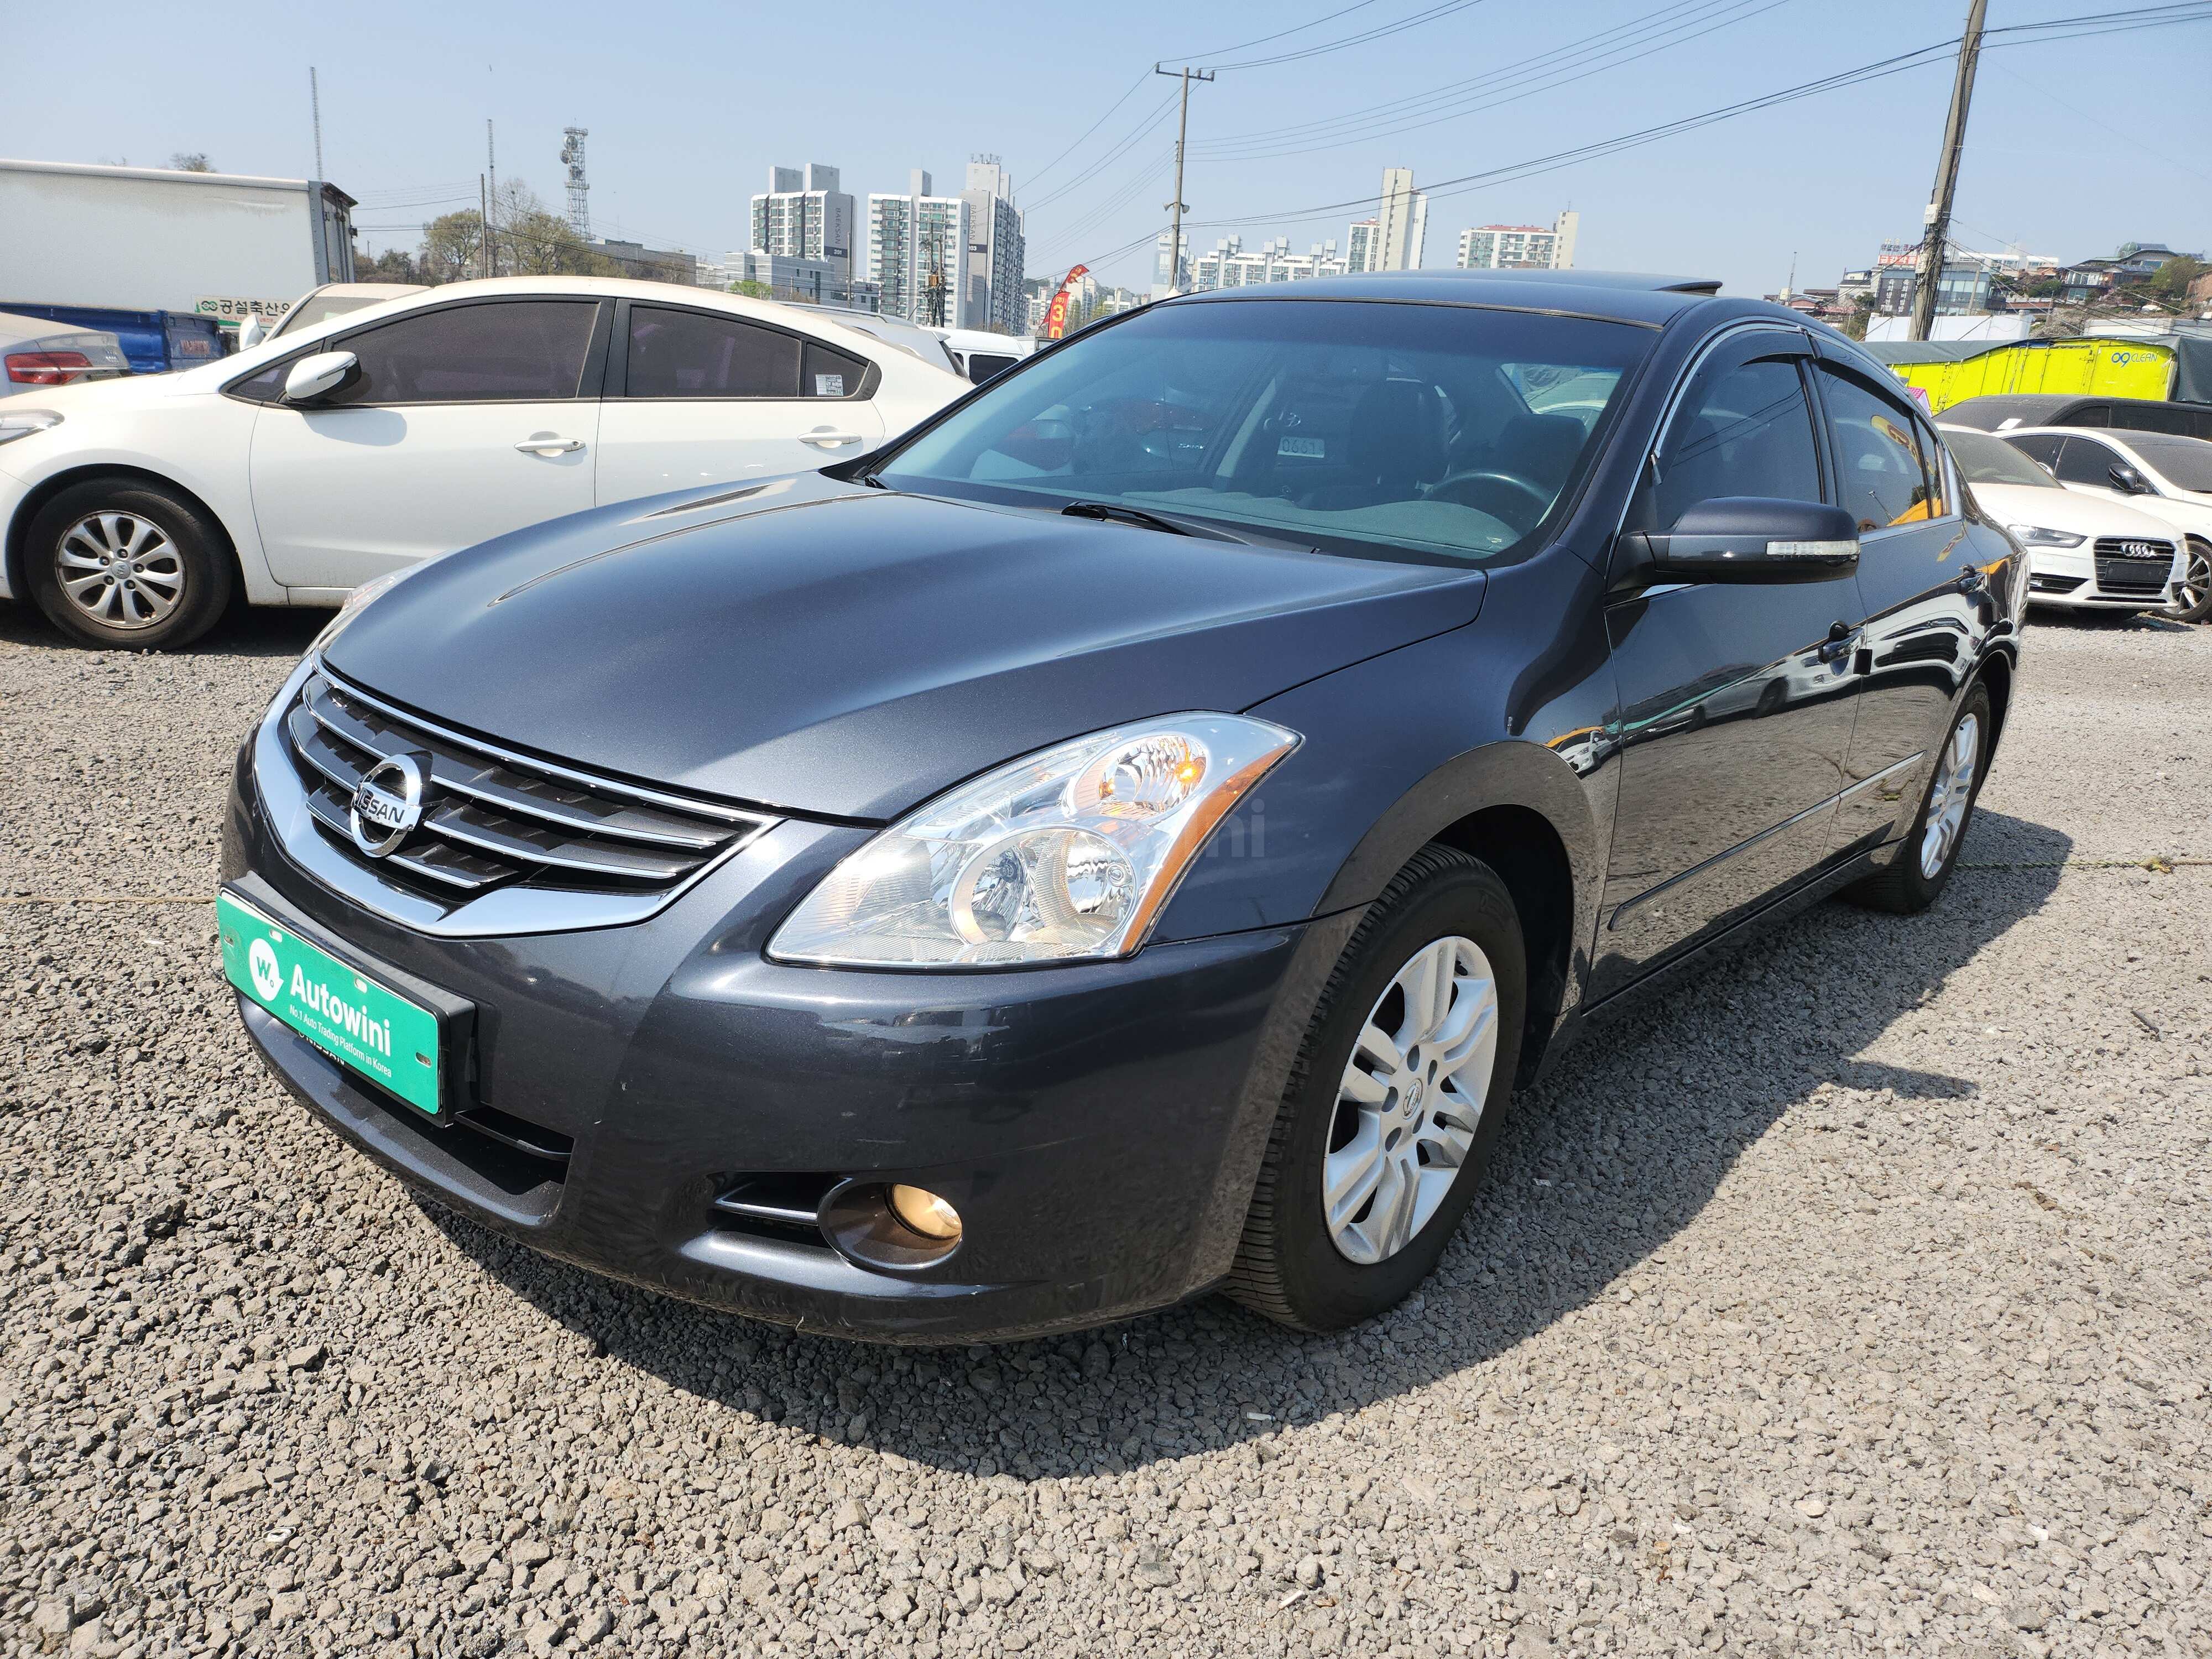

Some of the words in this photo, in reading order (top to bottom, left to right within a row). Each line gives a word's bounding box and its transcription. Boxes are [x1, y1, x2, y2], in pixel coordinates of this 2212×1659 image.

[2132, 353, 2158, 362] CLEAN
[289, 1004, 302, 1021] No.1
[303, 1013, 317, 1030] Auto
[318, 1021, 340, 1047] Trading
[340, 1036, 365, 1061] Platform
[366, 1052, 372, 1066] in
[373, 1058, 392, 1078] Korea
[290, 963, 391, 1057] Autowini
